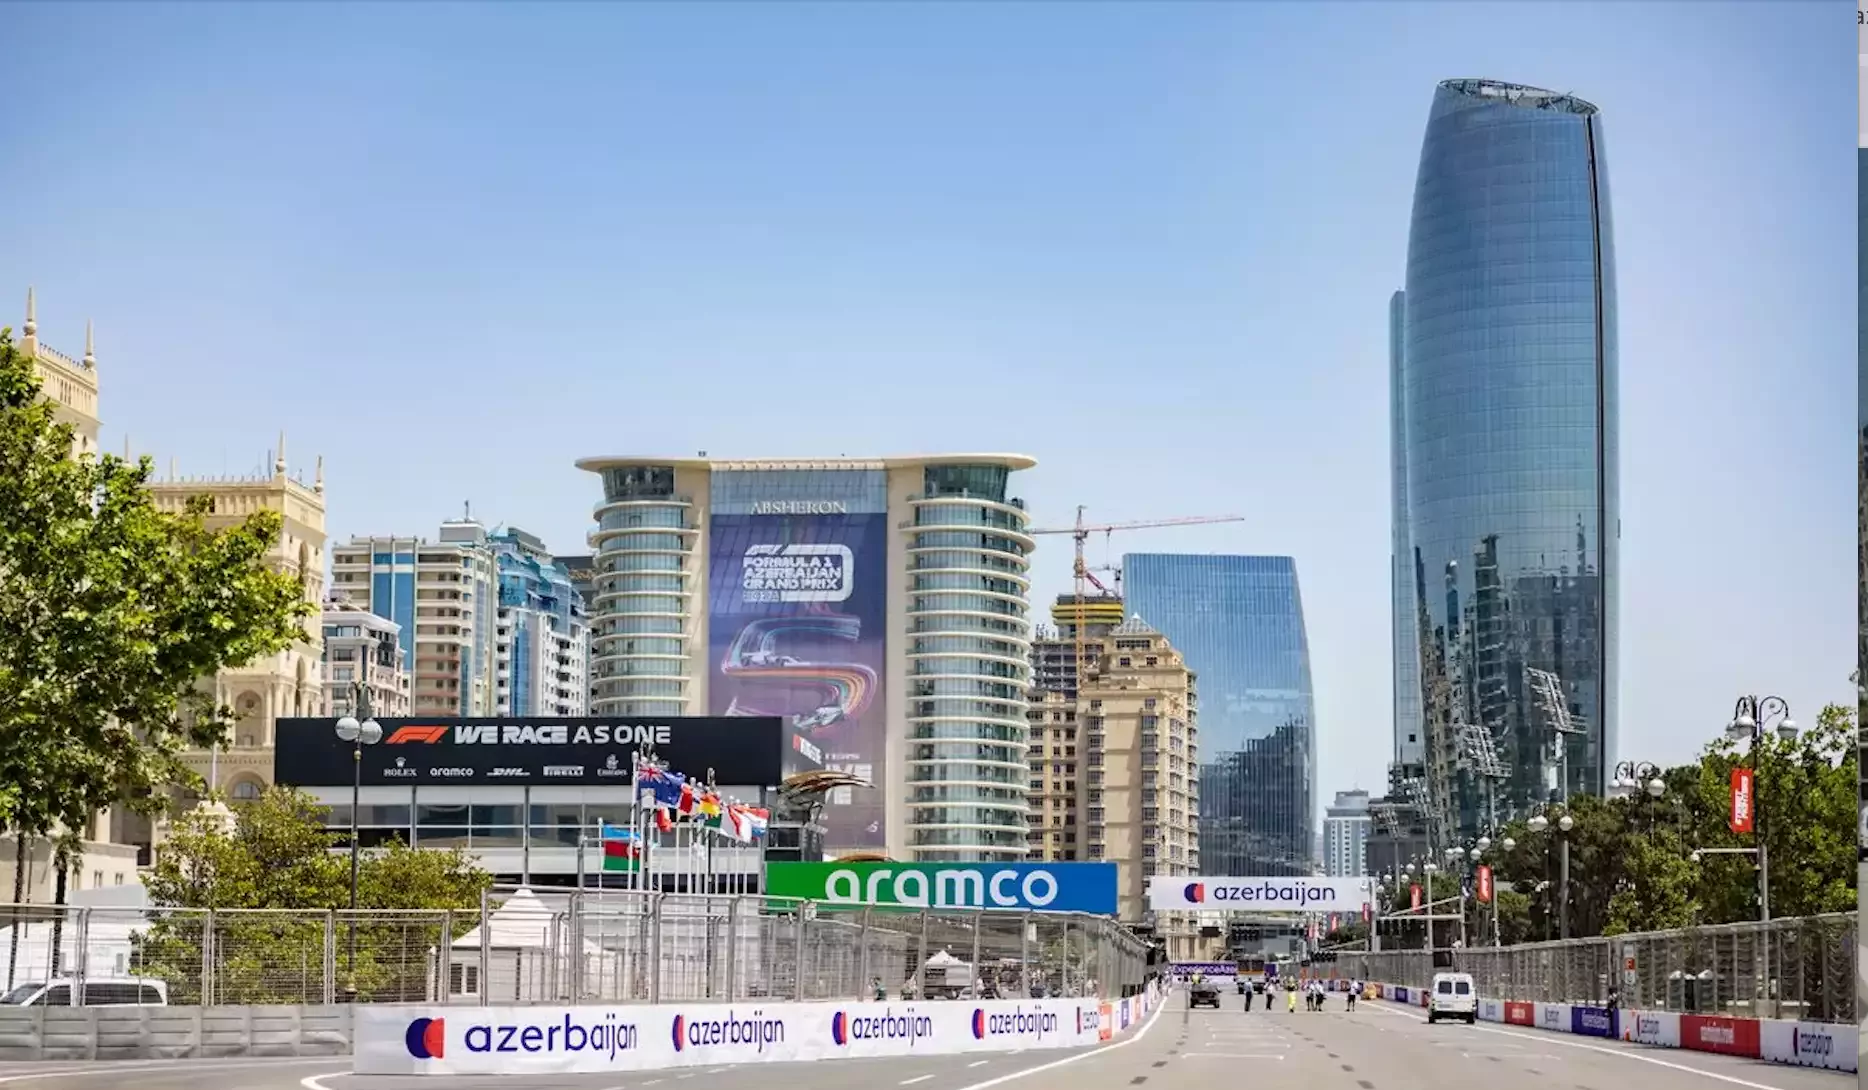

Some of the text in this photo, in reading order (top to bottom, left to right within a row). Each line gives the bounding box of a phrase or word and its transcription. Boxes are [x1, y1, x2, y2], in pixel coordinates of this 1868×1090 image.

[751, 500, 847, 514] ABSHERON
[743, 557, 833, 568] FORMULA 1
[743, 568, 842, 579] AZERBAIJAN
[743, 579, 838, 590] GRAND PRIX
[454, 726, 499, 744] WE
[502, 726, 568, 744] RACE
[572, 726, 610, 744] AS
[613, 726, 671, 744] ONE
[383, 767, 418, 777] ROLEX
[429, 767, 474, 777] aramco
[487, 767, 531, 776] DHL
[543, 765, 585, 776] PIRELLI
[825, 869, 1058, 907] aramco
[1214, 881, 1336, 906] azerbaijan
[688, 1008, 785, 1053] azerbaijan
[852, 1007, 932, 1047] azerbaijan
[989, 1004, 1057, 1041] azerbaijan
[465, 1013, 637, 1060] azerbaijan
